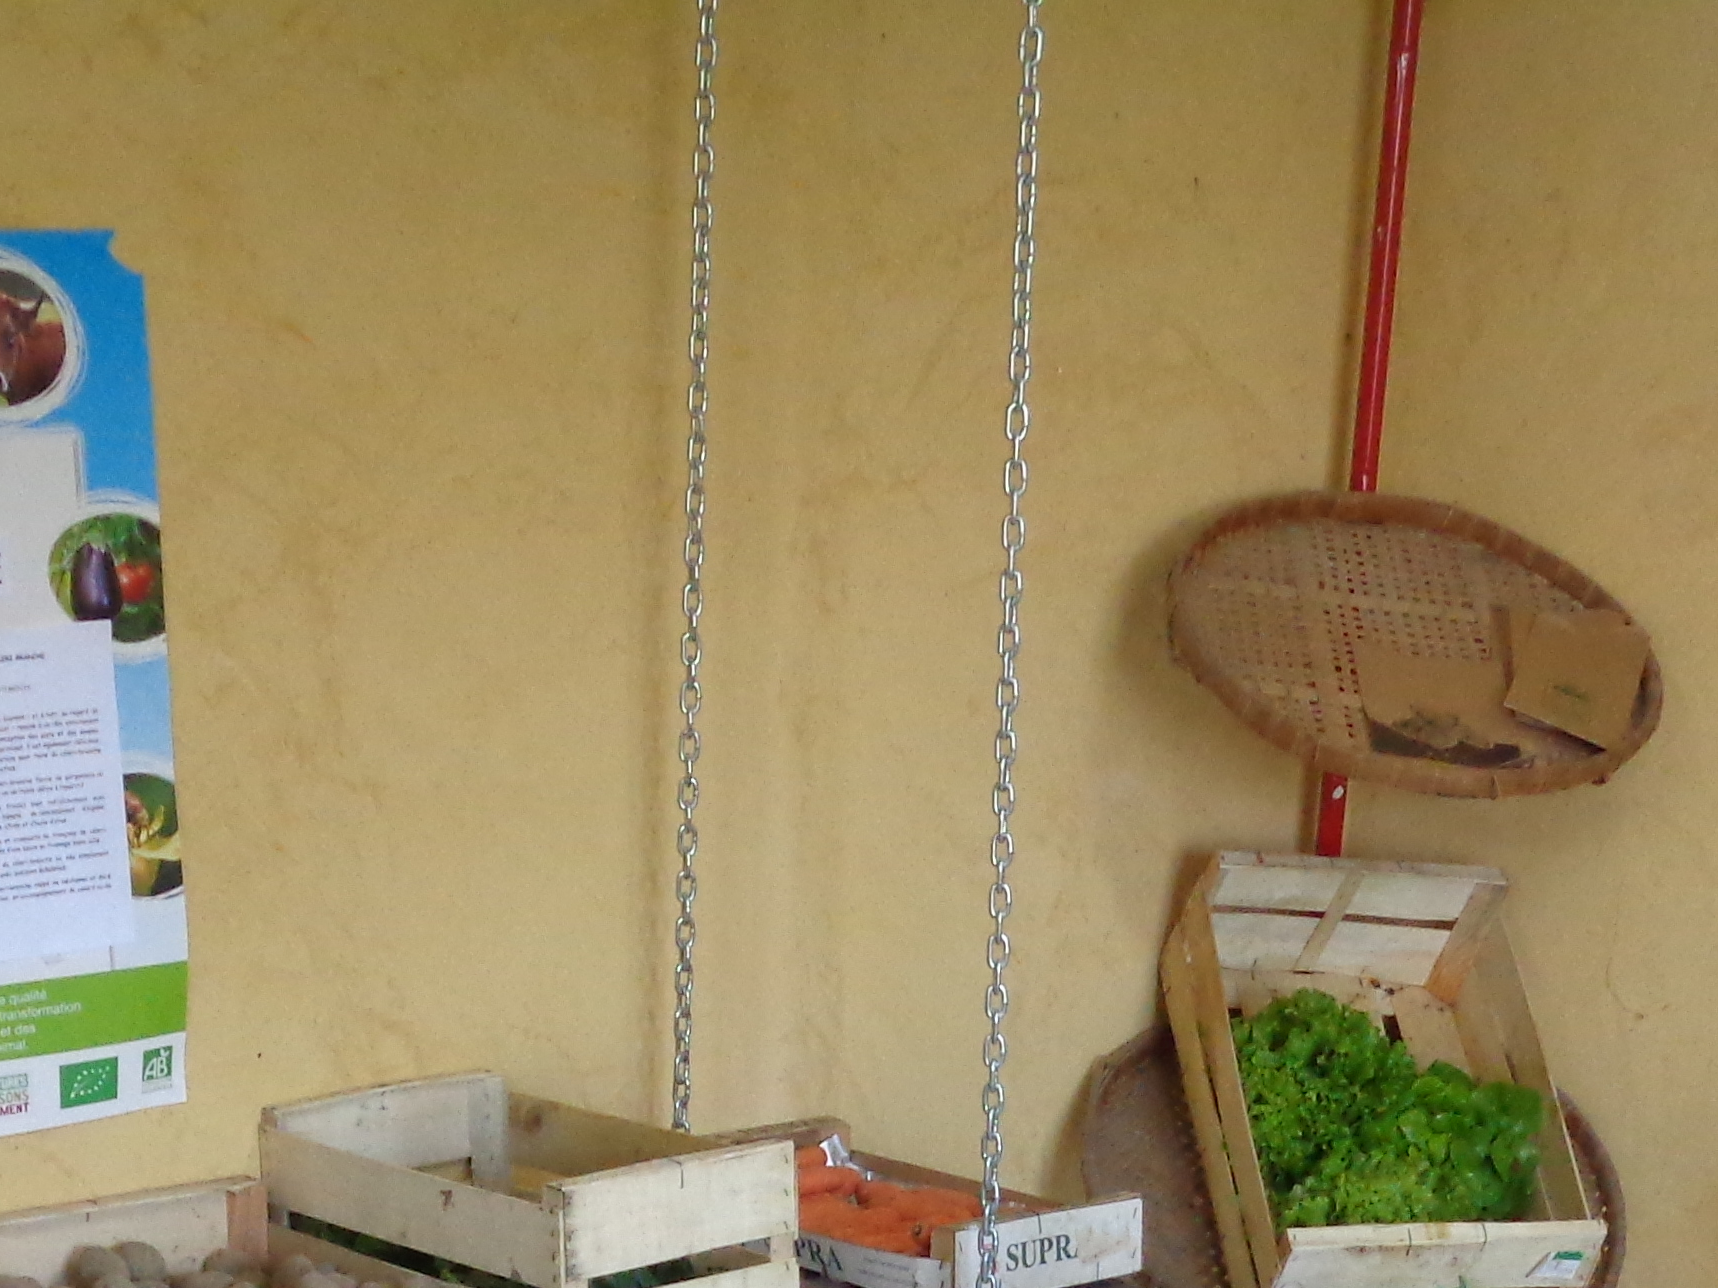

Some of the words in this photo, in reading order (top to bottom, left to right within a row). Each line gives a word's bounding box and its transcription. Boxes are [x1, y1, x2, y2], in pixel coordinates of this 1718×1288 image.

[9, 989, 48, 1005] qualité
[0, 1000, 81, 1022] transformation
[0, 1026, 11, 1038] et
[14, 1023, 36, 1036] des
[143, 1056, 168, 1081] AB
[1005, 1233, 1078, 1272] SUPR
